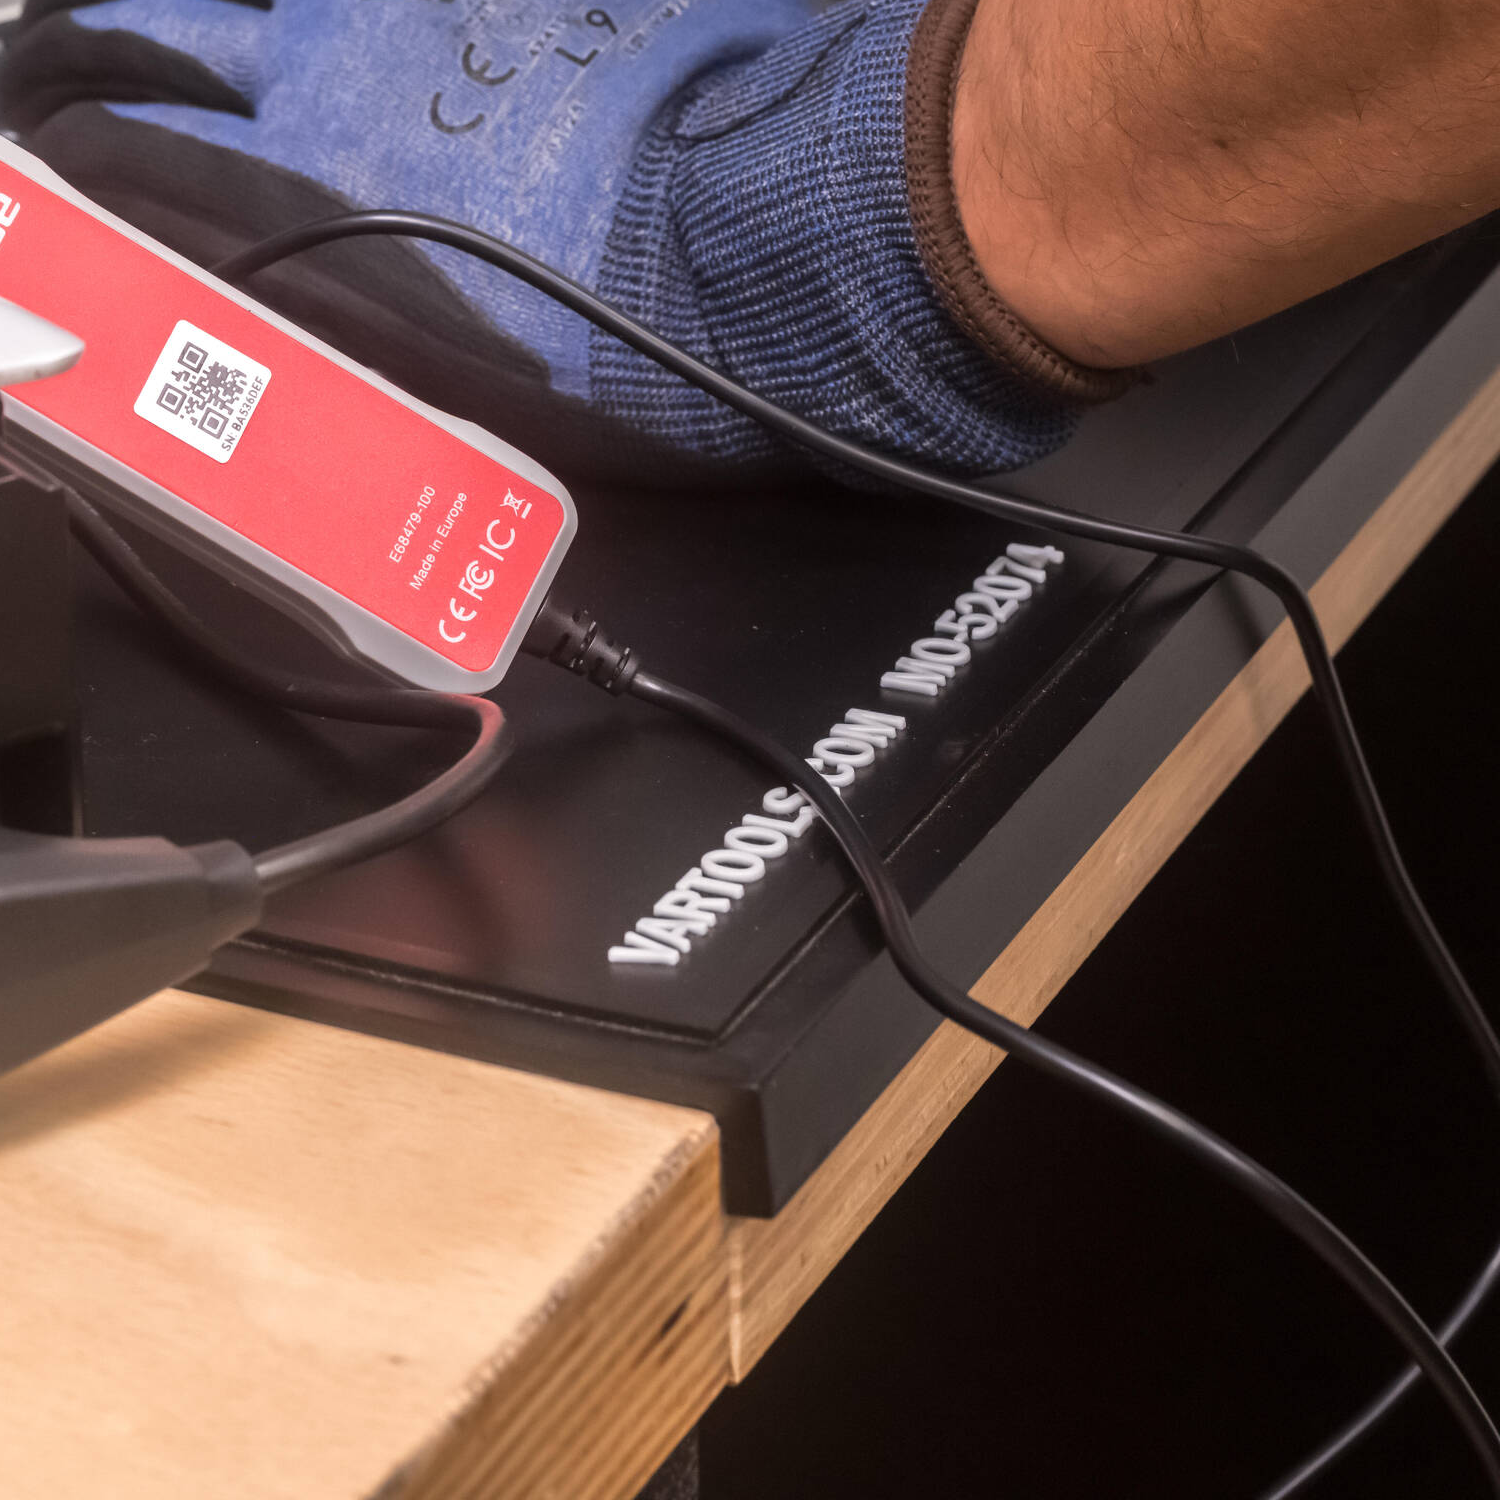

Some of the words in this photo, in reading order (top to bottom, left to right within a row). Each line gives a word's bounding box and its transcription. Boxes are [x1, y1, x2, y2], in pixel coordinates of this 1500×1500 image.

[555, 46, 598, 67] L
[231, 376, 264, 433] BA536DEF
[389, 485, 436, 563] E68479-100
[409, 553, 436, 591] Made
[428, 537, 444, 553] in
[437, 492, 467, 538] Europe
[478, 518, 516, 561] IC
[607, 707, 906, 966] VARTOOLSCOM
[880, 543, 1065, 696] MO-52074
